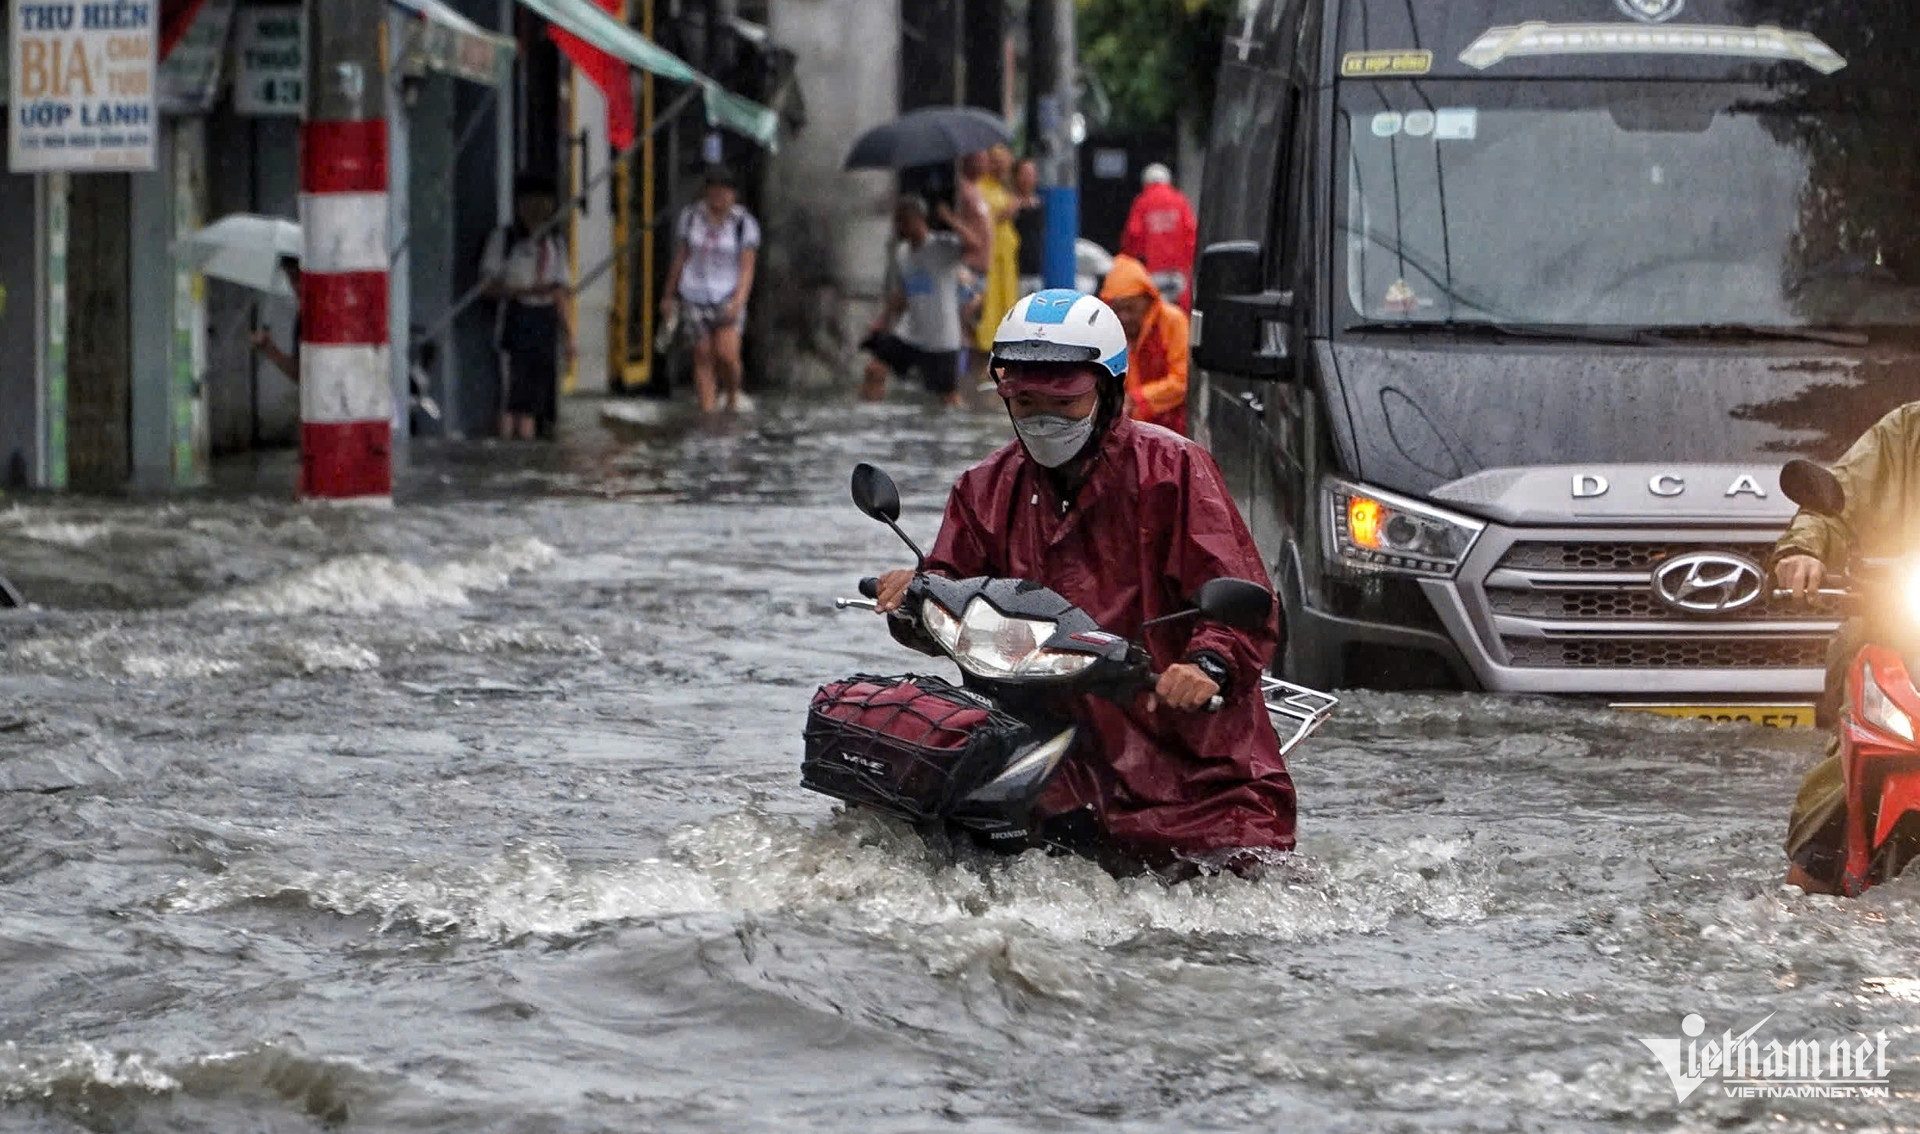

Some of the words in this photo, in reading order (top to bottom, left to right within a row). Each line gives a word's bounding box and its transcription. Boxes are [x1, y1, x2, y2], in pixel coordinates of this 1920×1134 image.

[21, 4, 74, 31] THU
[21, 39, 94, 98] BIA
[990, 828, 1028, 840] HONDA
